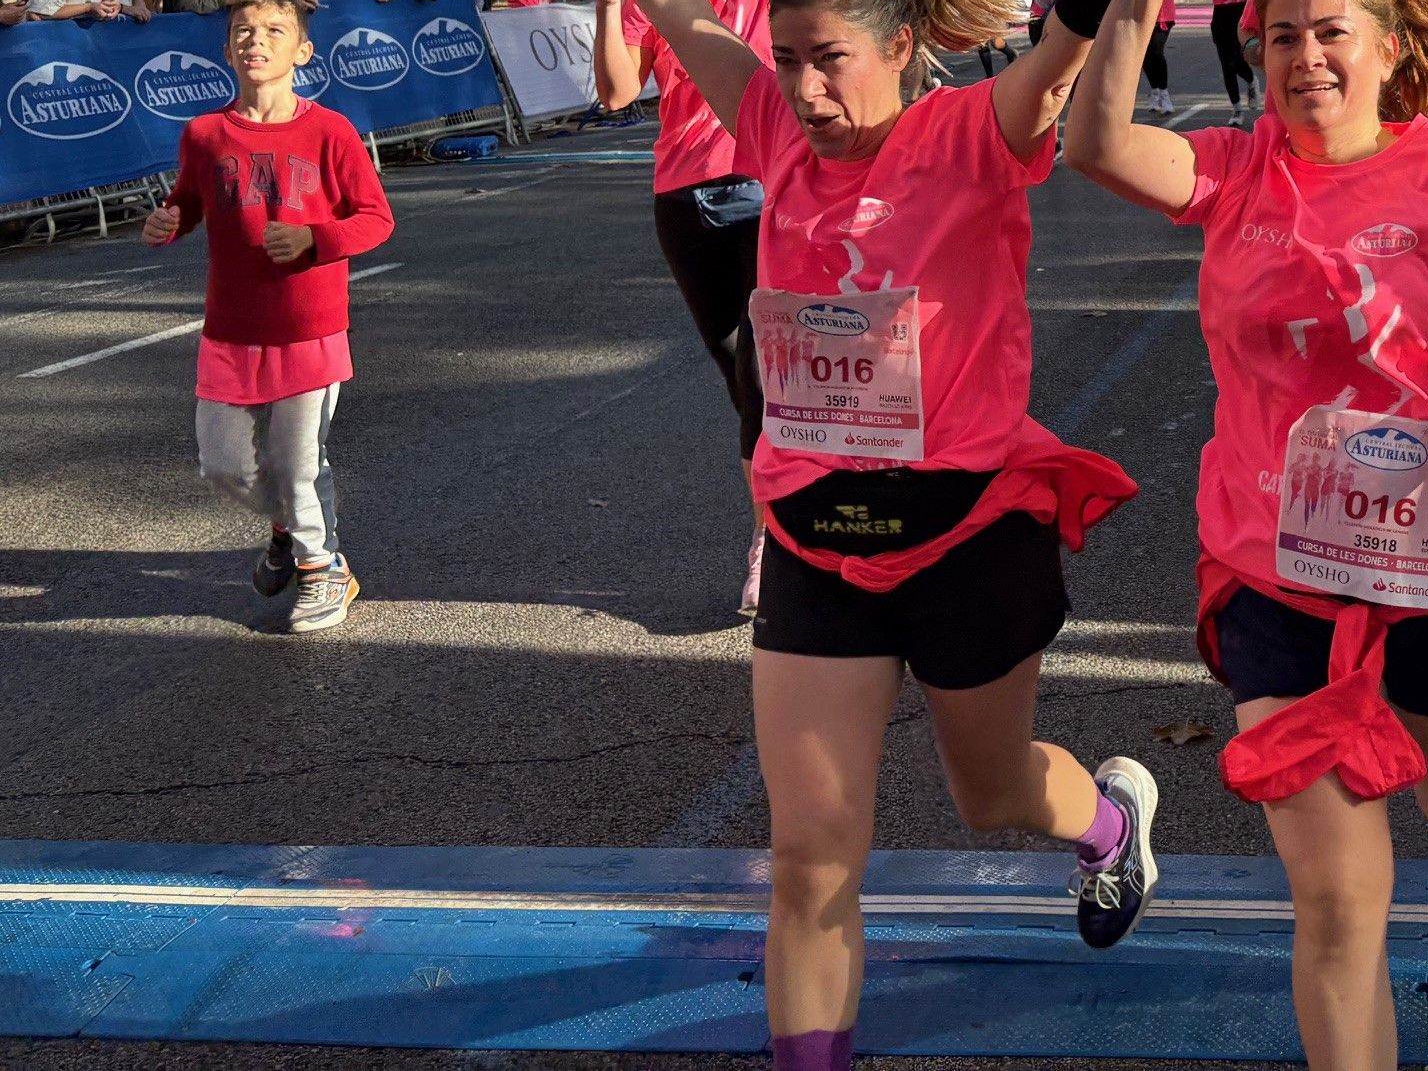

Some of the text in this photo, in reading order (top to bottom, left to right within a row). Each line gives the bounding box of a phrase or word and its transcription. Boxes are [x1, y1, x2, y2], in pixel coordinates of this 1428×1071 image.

[337, 52, 405, 79] ASTURIANA
[32, 88, 72, 100] CENTRAL
[142, 79, 230, 107] ASTURIANA
[20, 91, 124, 126] ASTURIANA
[1240, 223, 1294, 249] OYSH
[804, 312, 865, 331] ASTURIANA
[810, 355, 874, 384] 016
[825, 394, 860, 408] 35919
[879, 394, 912, 404] HUAWEI
[779, 408, 903, 425] CURSA DE LES DONES BARCELONA
[780, 425, 827, 443] OYSHO
[856, 435, 904, 448] Santander
[1300, 435, 1337, 452] SUMA
[1350, 438, 1423, 465] ASTURIANA
[1344, 489, 1417, 528] 016
[813, 519, 903, 535] HANKER
[1353, 534, 1398, 553] 35918
[1297, 540, 1325, 556] CURSA
[1326, 546, 1337, 558] DE
[1339, 548, 1356, 561] LES
[1357, 553, 1389, 567] DONES
[1294, 559, 1351, 585] OYSHO
